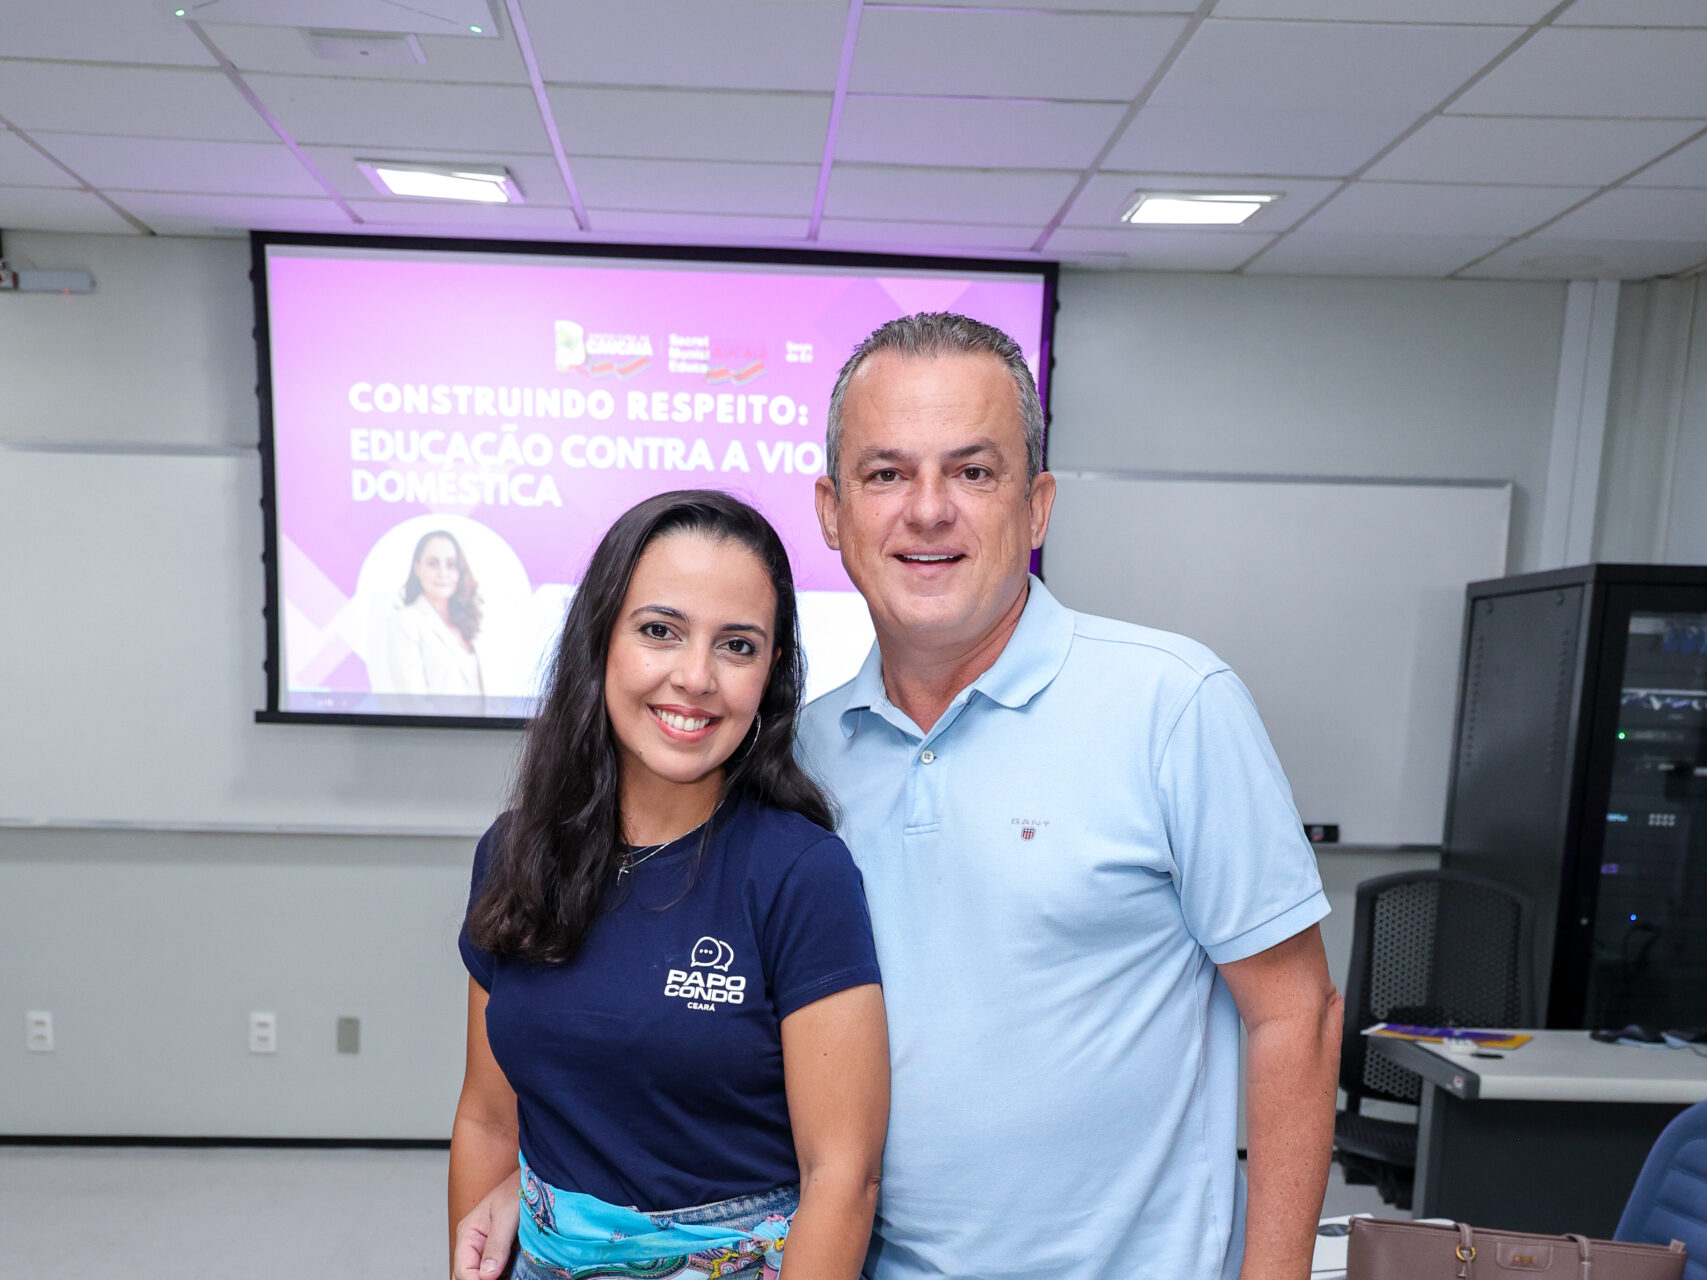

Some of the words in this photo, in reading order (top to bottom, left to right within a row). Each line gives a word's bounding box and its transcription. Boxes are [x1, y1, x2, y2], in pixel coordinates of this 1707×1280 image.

[349, 382, 615, 420] CONSTRUINDO
[627, 390, 808, 425] RESPEITO:
[350, 423, 553, 470] EDUCAÇÃO
[560, 434, 715, 471] CONTRA
[721, 440, 750, 473] A
[756, 440, 828, 476] VIO
[351, 463, 563, 507] DOMÉSTICA
[1011, 817, 1051, 827] GANT
[666, 969, 746, 991] PAPO
[664, 984, 744, 1004] CONDO
[687, 1001, 715, 1012] CEARÁ
